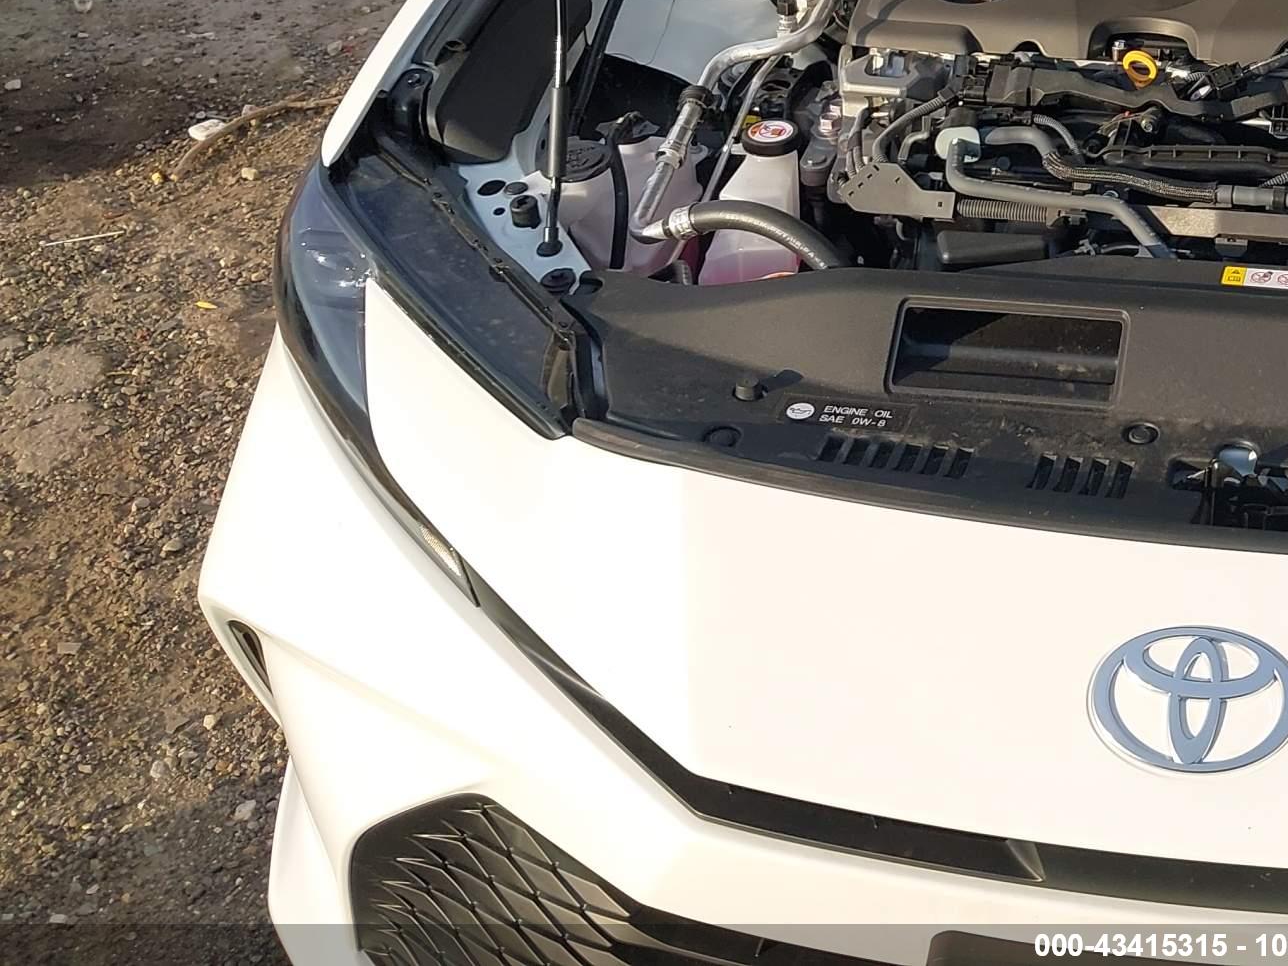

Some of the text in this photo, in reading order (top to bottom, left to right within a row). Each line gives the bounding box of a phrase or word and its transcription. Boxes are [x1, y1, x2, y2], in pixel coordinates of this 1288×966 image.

[823, 405, 893, 419] ENGINE OIL
[819, 414, 887, 427] SAE 0W-8
